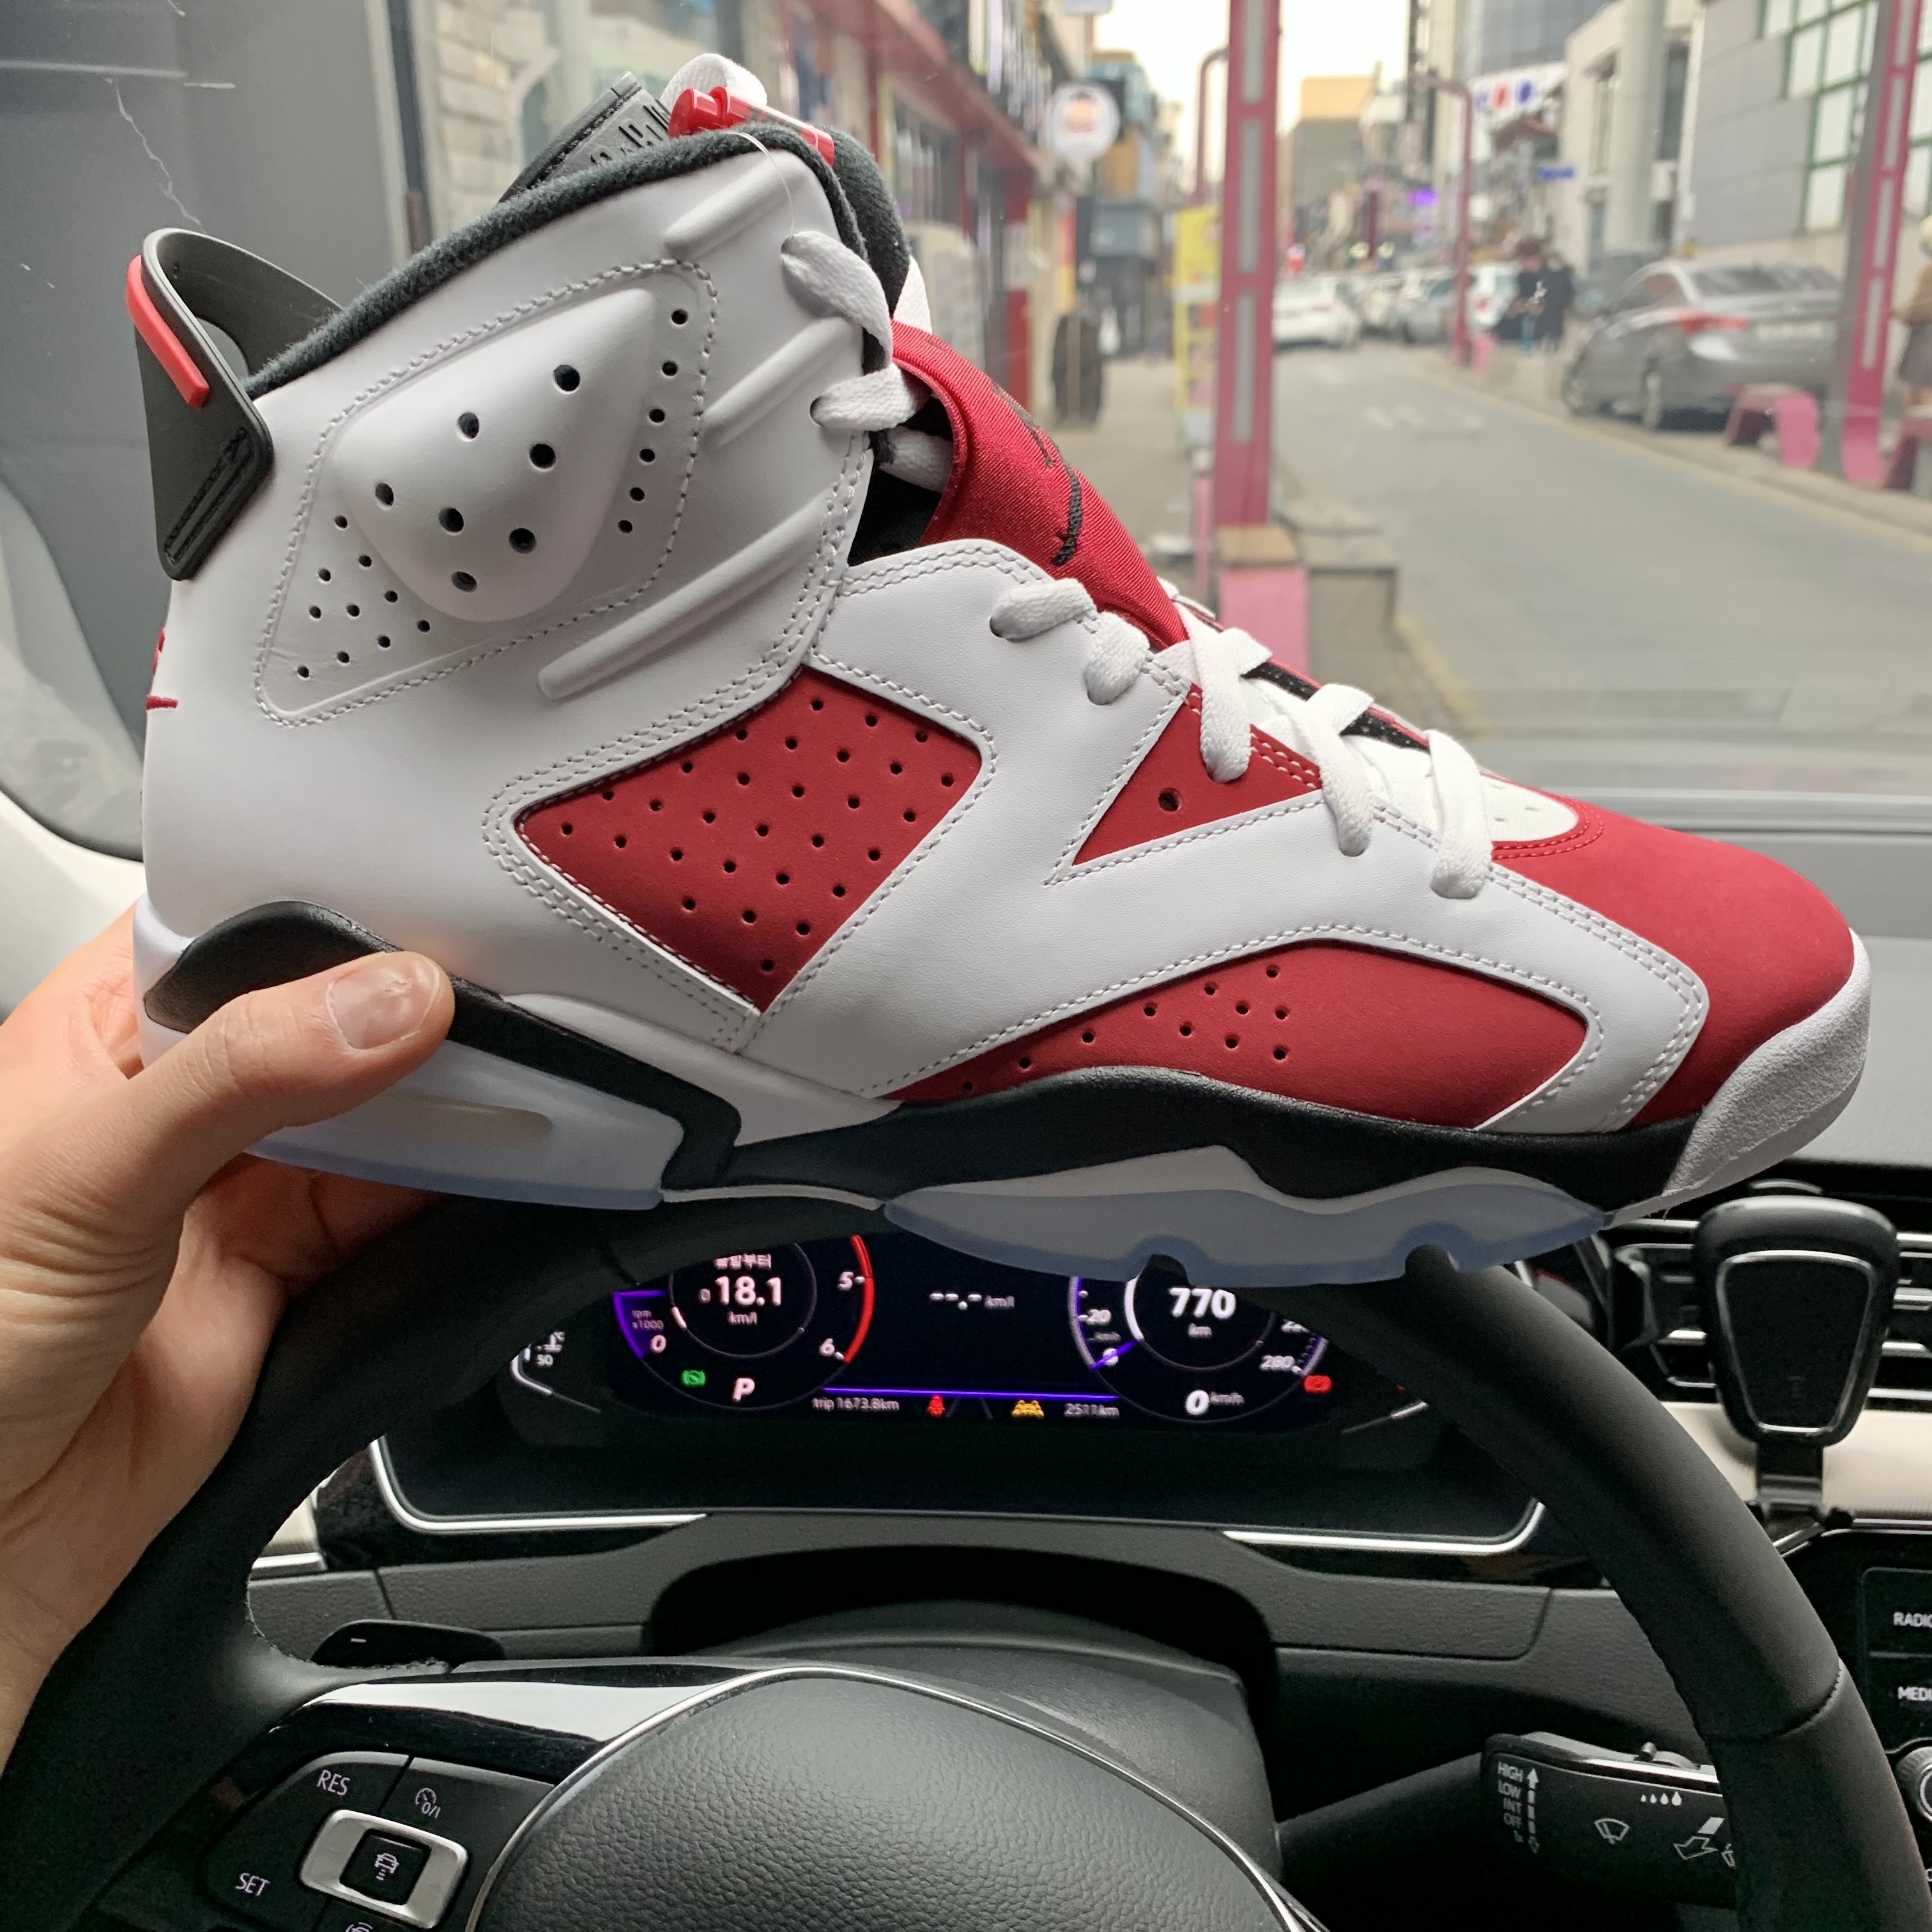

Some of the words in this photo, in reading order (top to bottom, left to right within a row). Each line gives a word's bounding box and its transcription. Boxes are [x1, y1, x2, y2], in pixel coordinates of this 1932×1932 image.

[716, 1276, 781, 1306] 18.1
[837, 1271, 854, 1291] 5
[1169, 1287, 1236, 1319] 770
[1087, 1309, 1111, 1324] 20
[1188, 1323, 1212, 1338] km
[650, 1335, 666, 1353] 0
[819, 1338, 835, 1356] 6
[733, 1377, 755, 1402] P
[811, 1397, 834, 1411] trip
[1186, 1390, 1209, 1416] 0
[1498, 1761, 1523, 1782] HIGH
[318, 1769, 351, 1796] RES
[1498, 1779, 1521, 1799] LOW
[1503, 1813, 1522, 1828] OFF
[235, 1873, 270, 1896] SET
